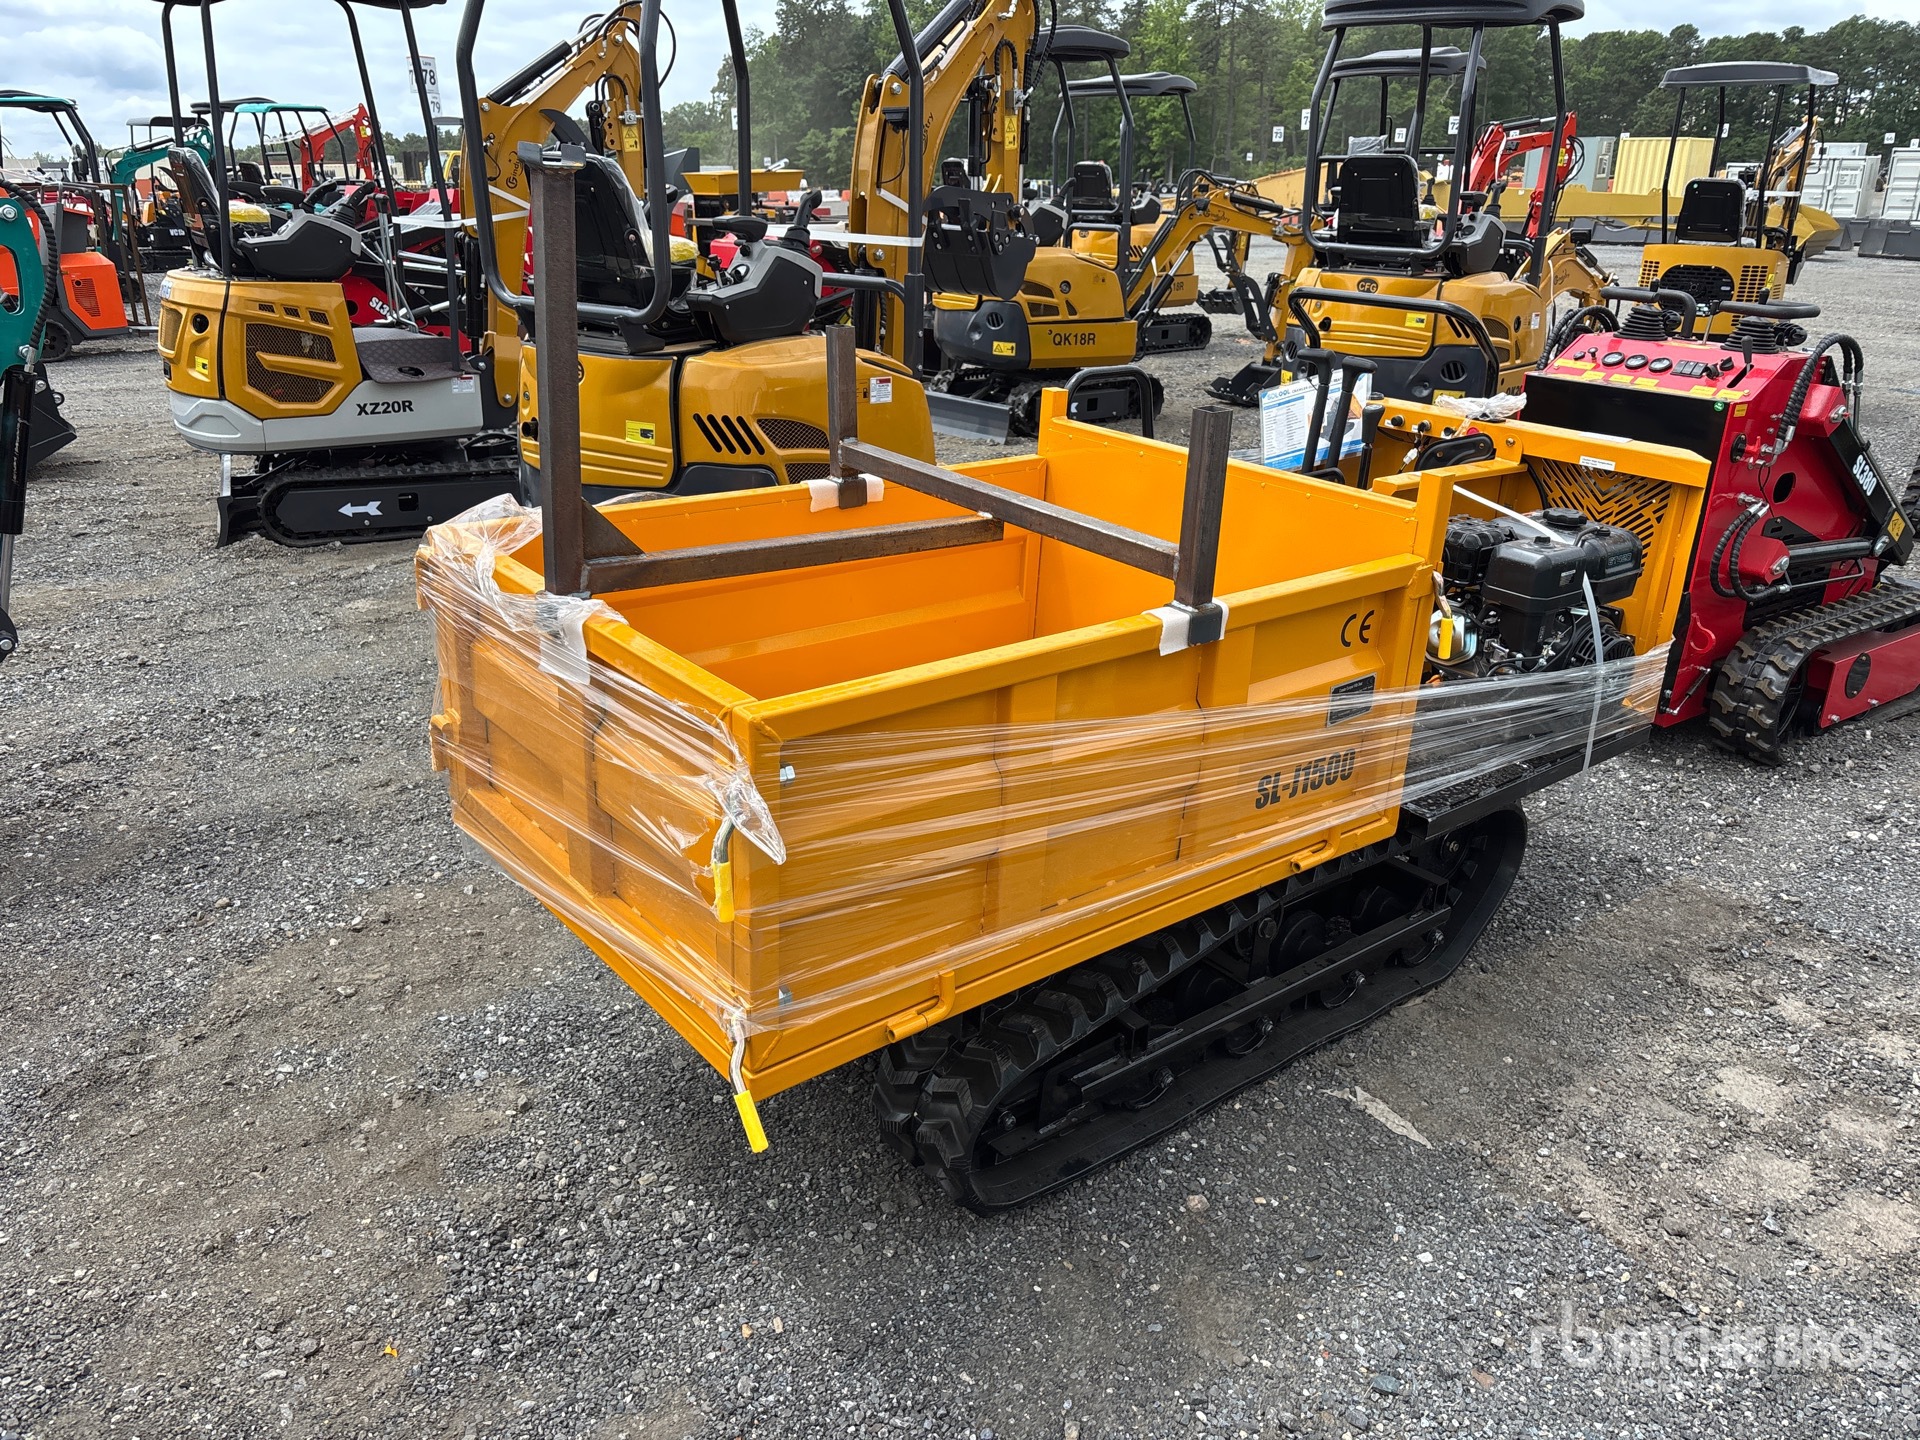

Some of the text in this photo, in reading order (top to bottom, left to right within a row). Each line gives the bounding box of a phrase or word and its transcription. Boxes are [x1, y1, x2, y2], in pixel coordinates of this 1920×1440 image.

[422, 69, 436, 86] 78
[431, 101, 441, 113] 79
[1450, 122, 1459, 131] 72
[1274, 131, 1283, 139] 73
[1358, 281, 1377, 292] CFG
[1052, 332, 1096, 346] QK18R
[356, 400, 414, 416] XZ20R
[1852, 454, 1877, 496] SL380
[1340, 609, 1375, 647] CE
[1255, 748, 1356, 809] SL-J1500
